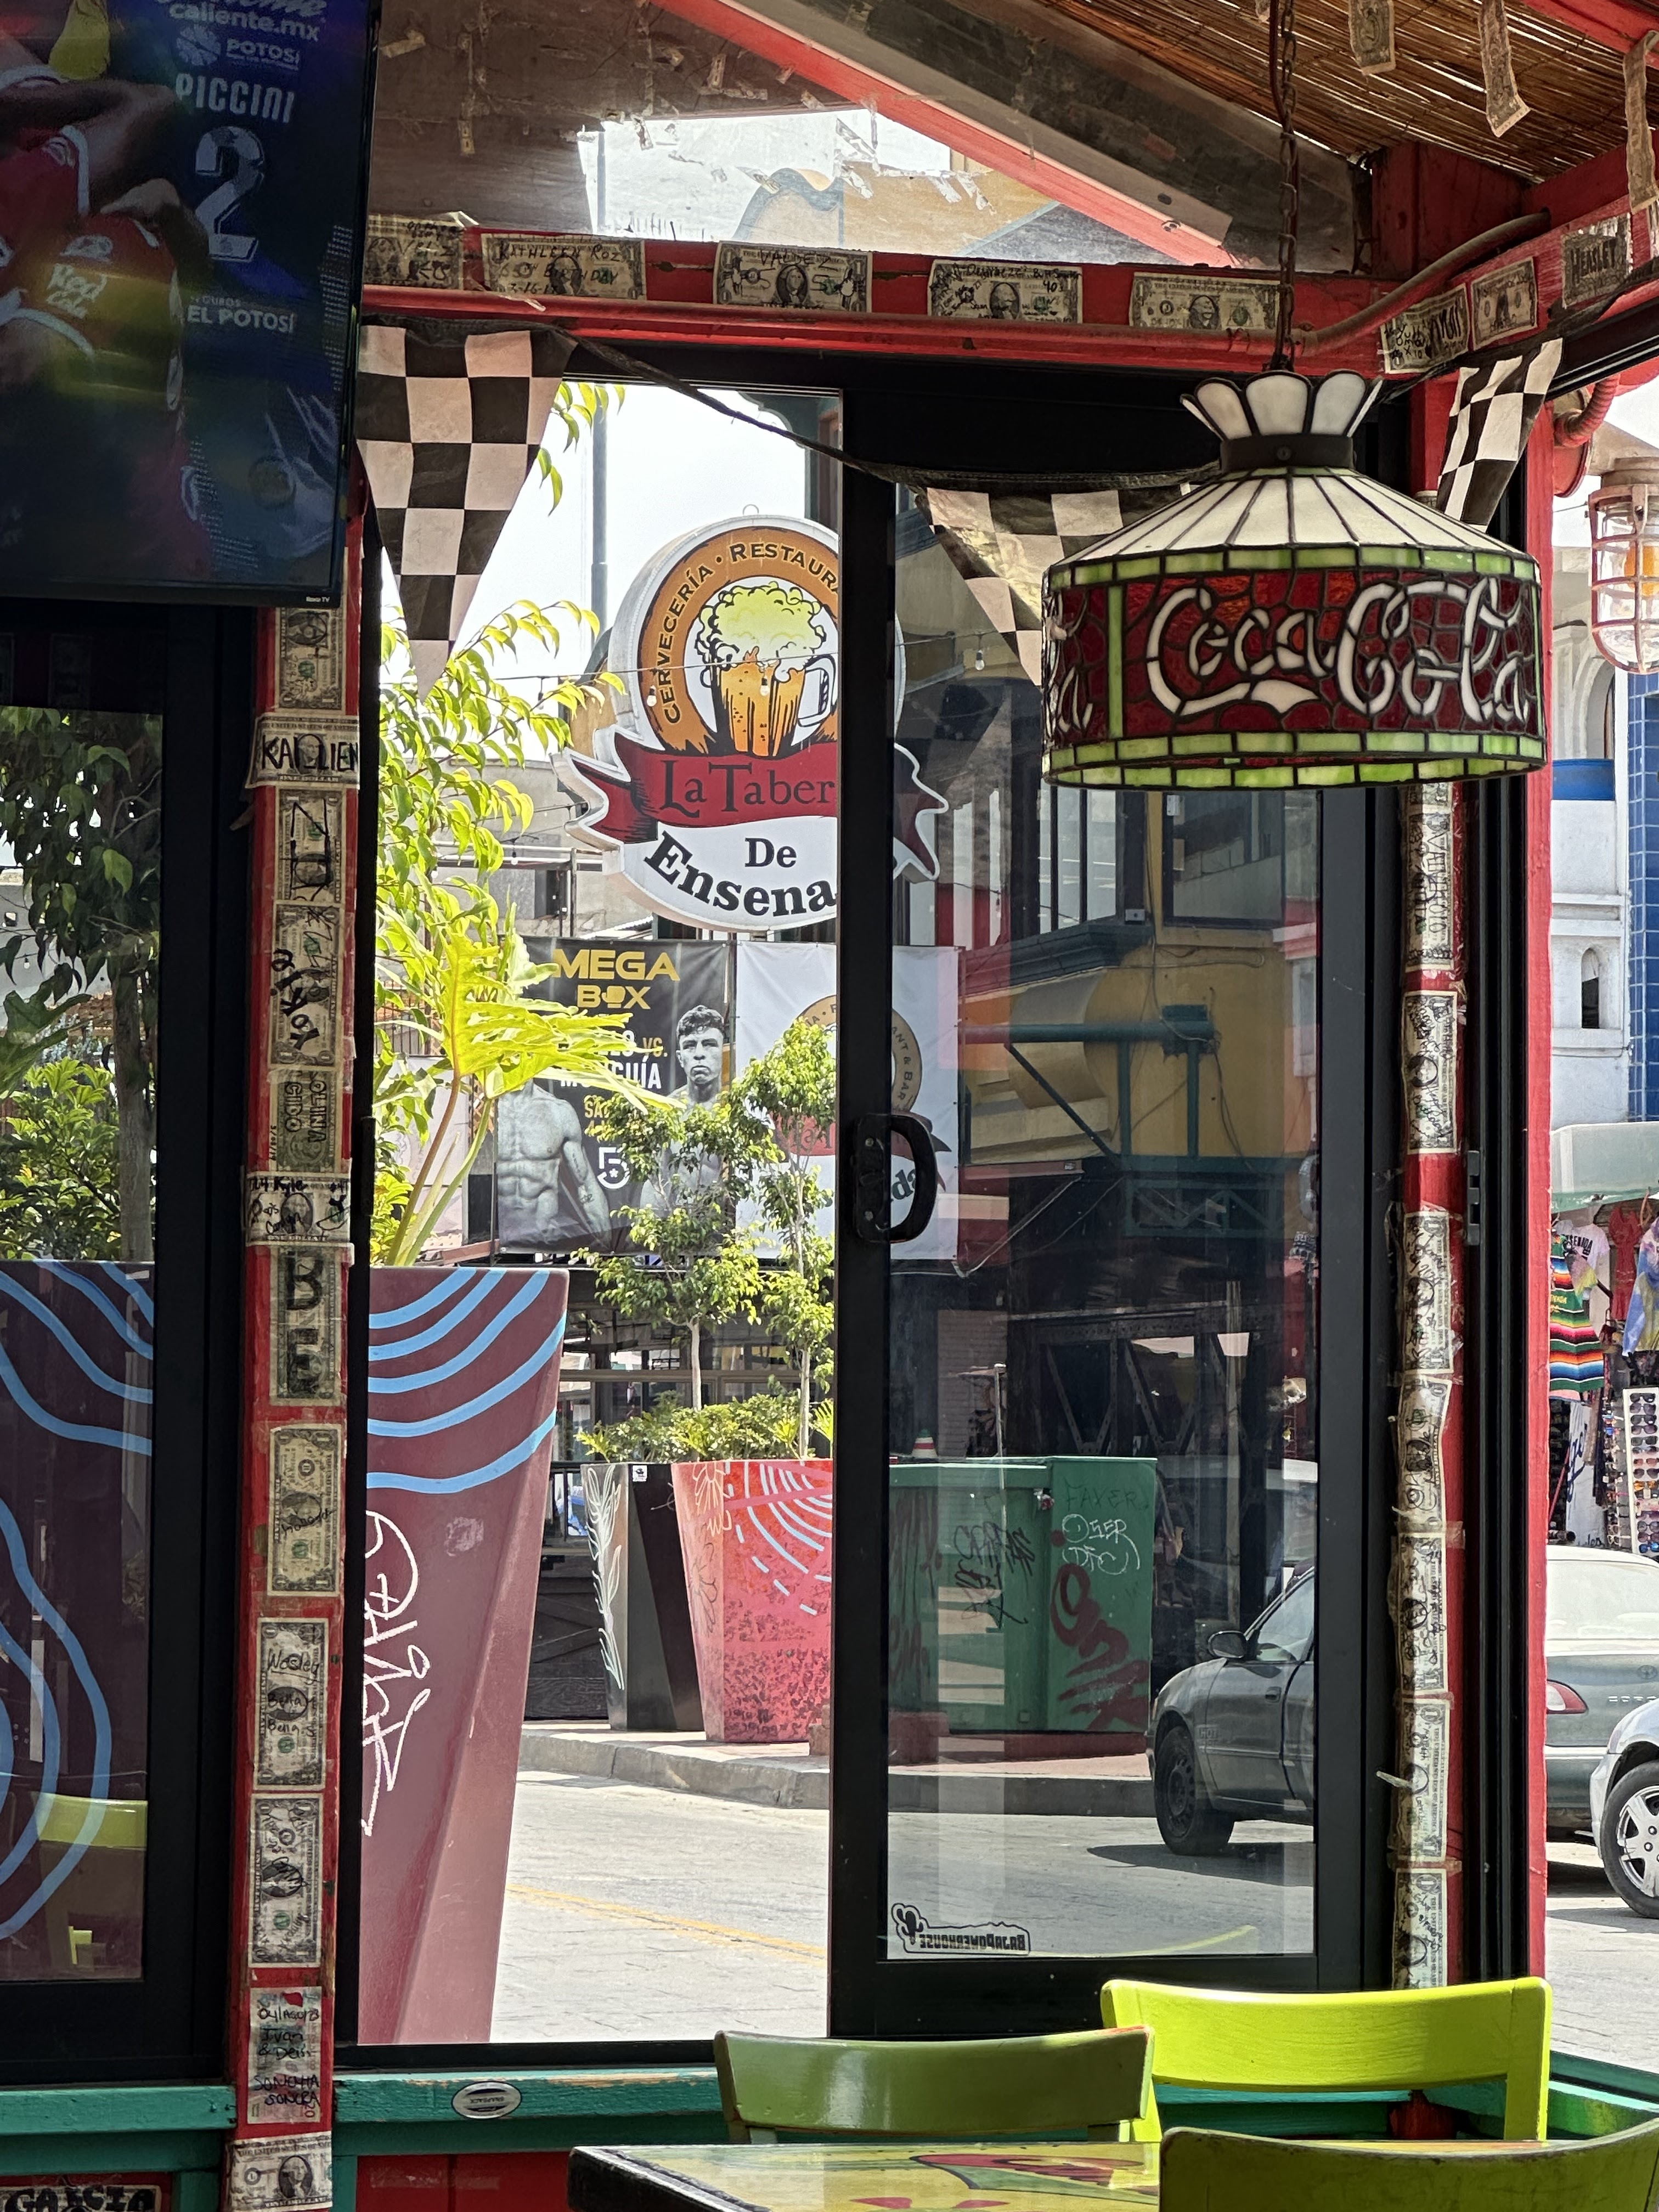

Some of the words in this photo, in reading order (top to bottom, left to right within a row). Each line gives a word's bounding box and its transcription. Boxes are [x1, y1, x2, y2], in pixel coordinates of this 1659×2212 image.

[169, 3, 320, 42] caliente.mx
[175, 72, 295, 123] PICCINI
[195, 126, 264, 262] 2
[187, 304, 213, 324] EL
[654, 566, 715, 725] CERVECERÍA
[730, 543, 838, 595] RESTAUR
[1144, 586, 1336, 715] Coca
[1336, 576, 1534, 724] Cola
[661, 760, 706, 819] La
[707, 760, 836, 815] Taber
[644, 830, 837, 918] Ensena
[744, 837, 798, 868] De
[551, 948, 680, 981] MEGA
[577, 984, 651, 1010] BOX
